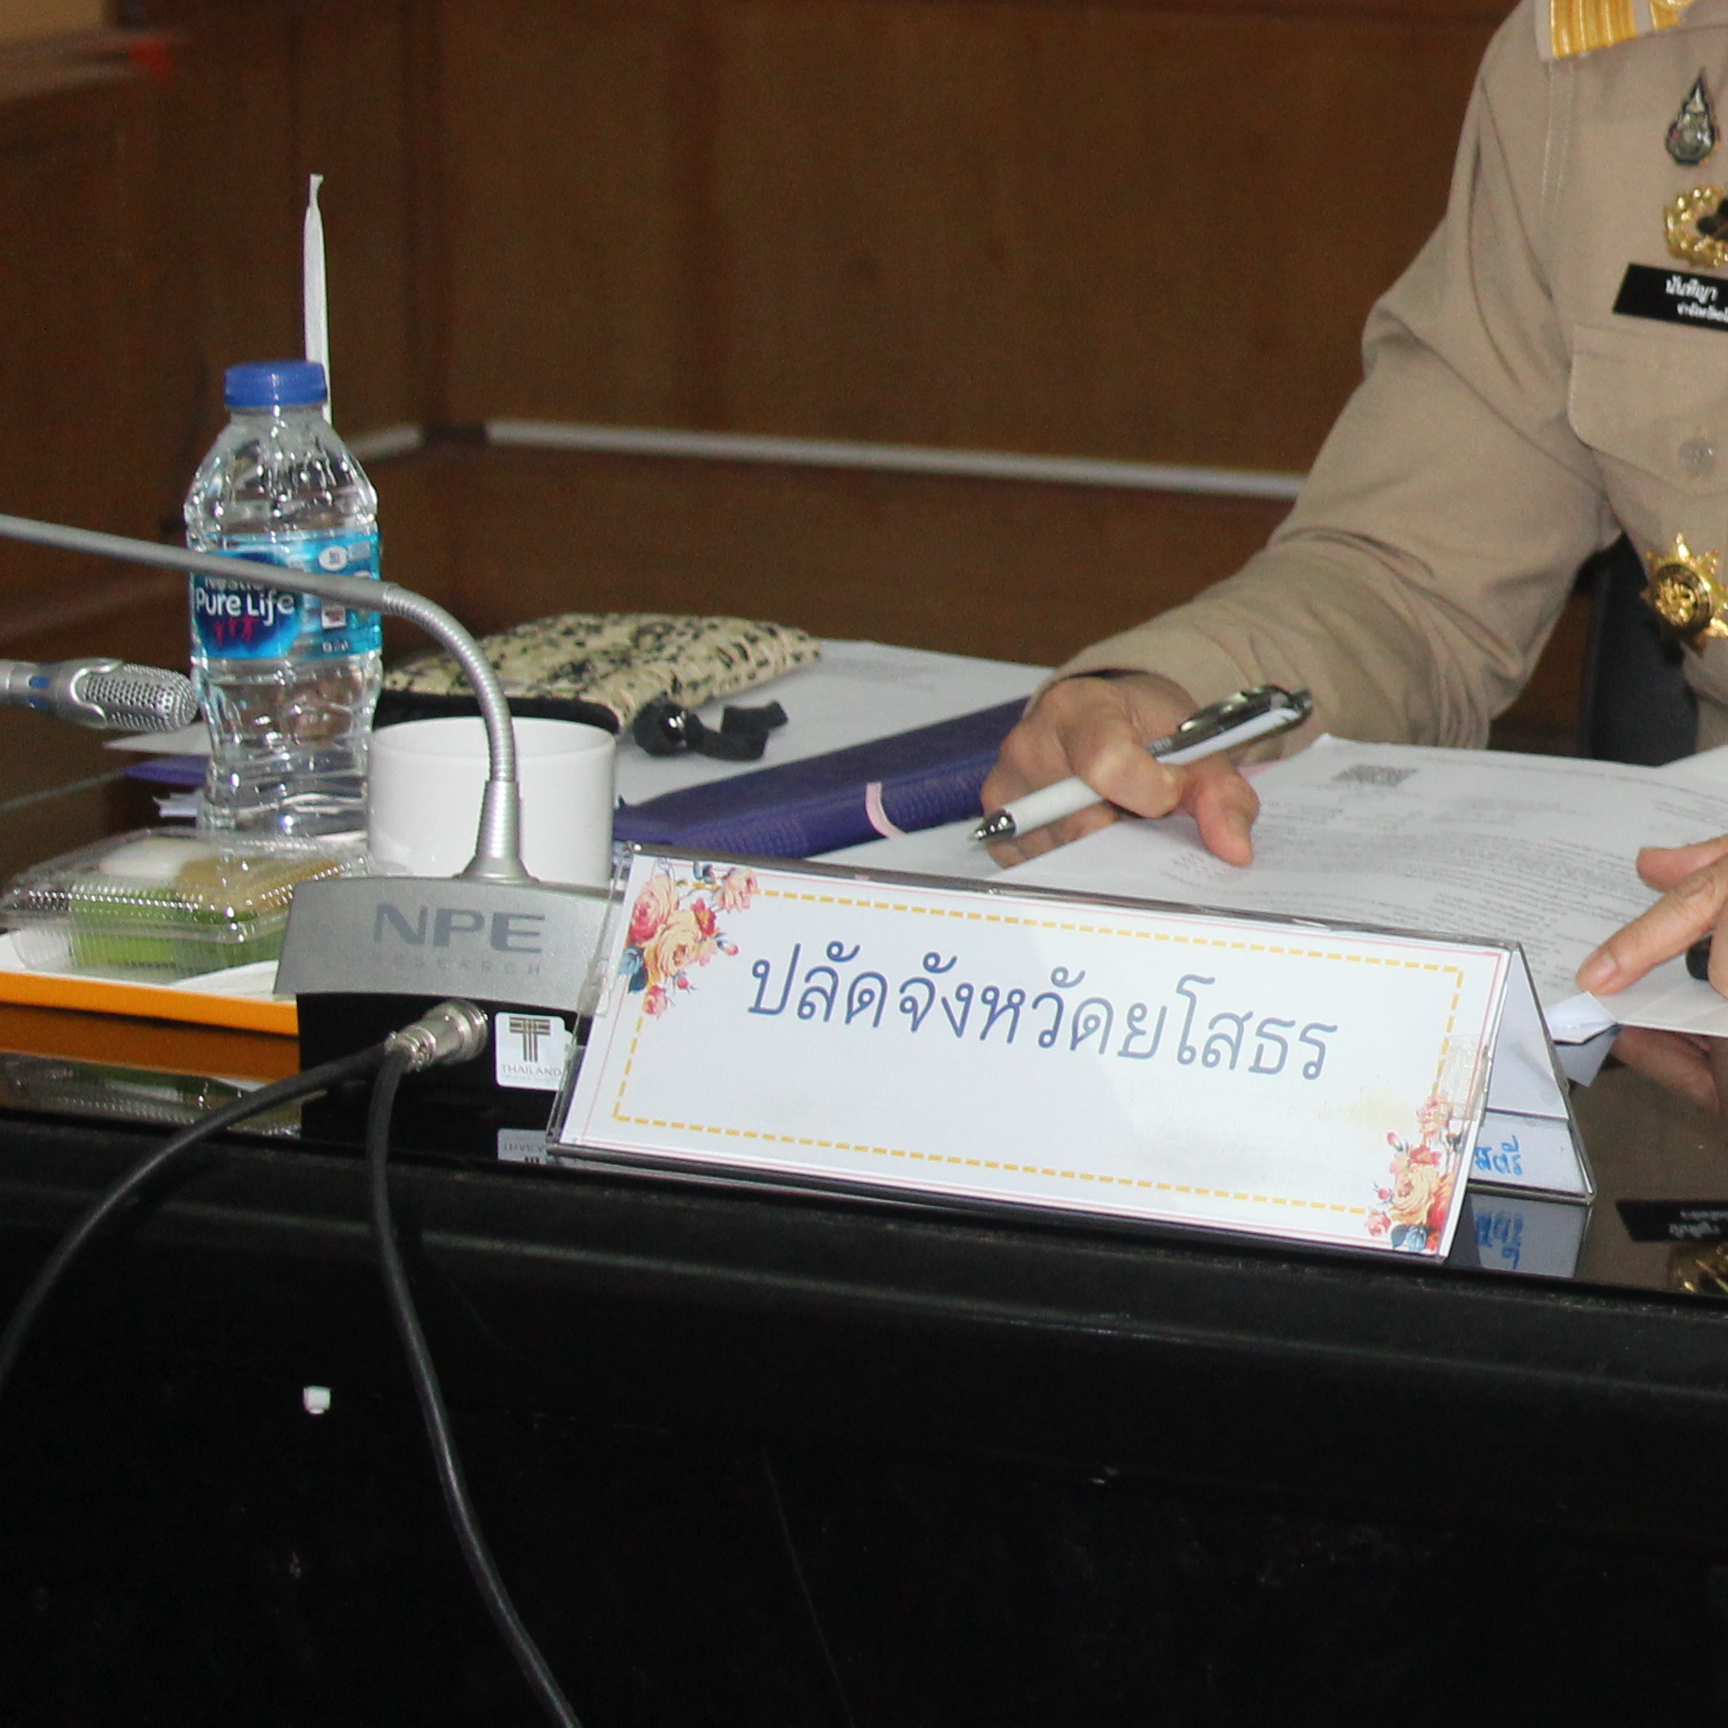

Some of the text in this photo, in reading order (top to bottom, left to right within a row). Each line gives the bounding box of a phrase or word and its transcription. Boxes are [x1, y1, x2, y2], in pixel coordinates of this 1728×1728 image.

[195, 587, 295, 627] Pure Life
[373, 903, 546, 954] NPE
[747, 940, 1338, 1081] ปลัดจังหวัดยโสธร
